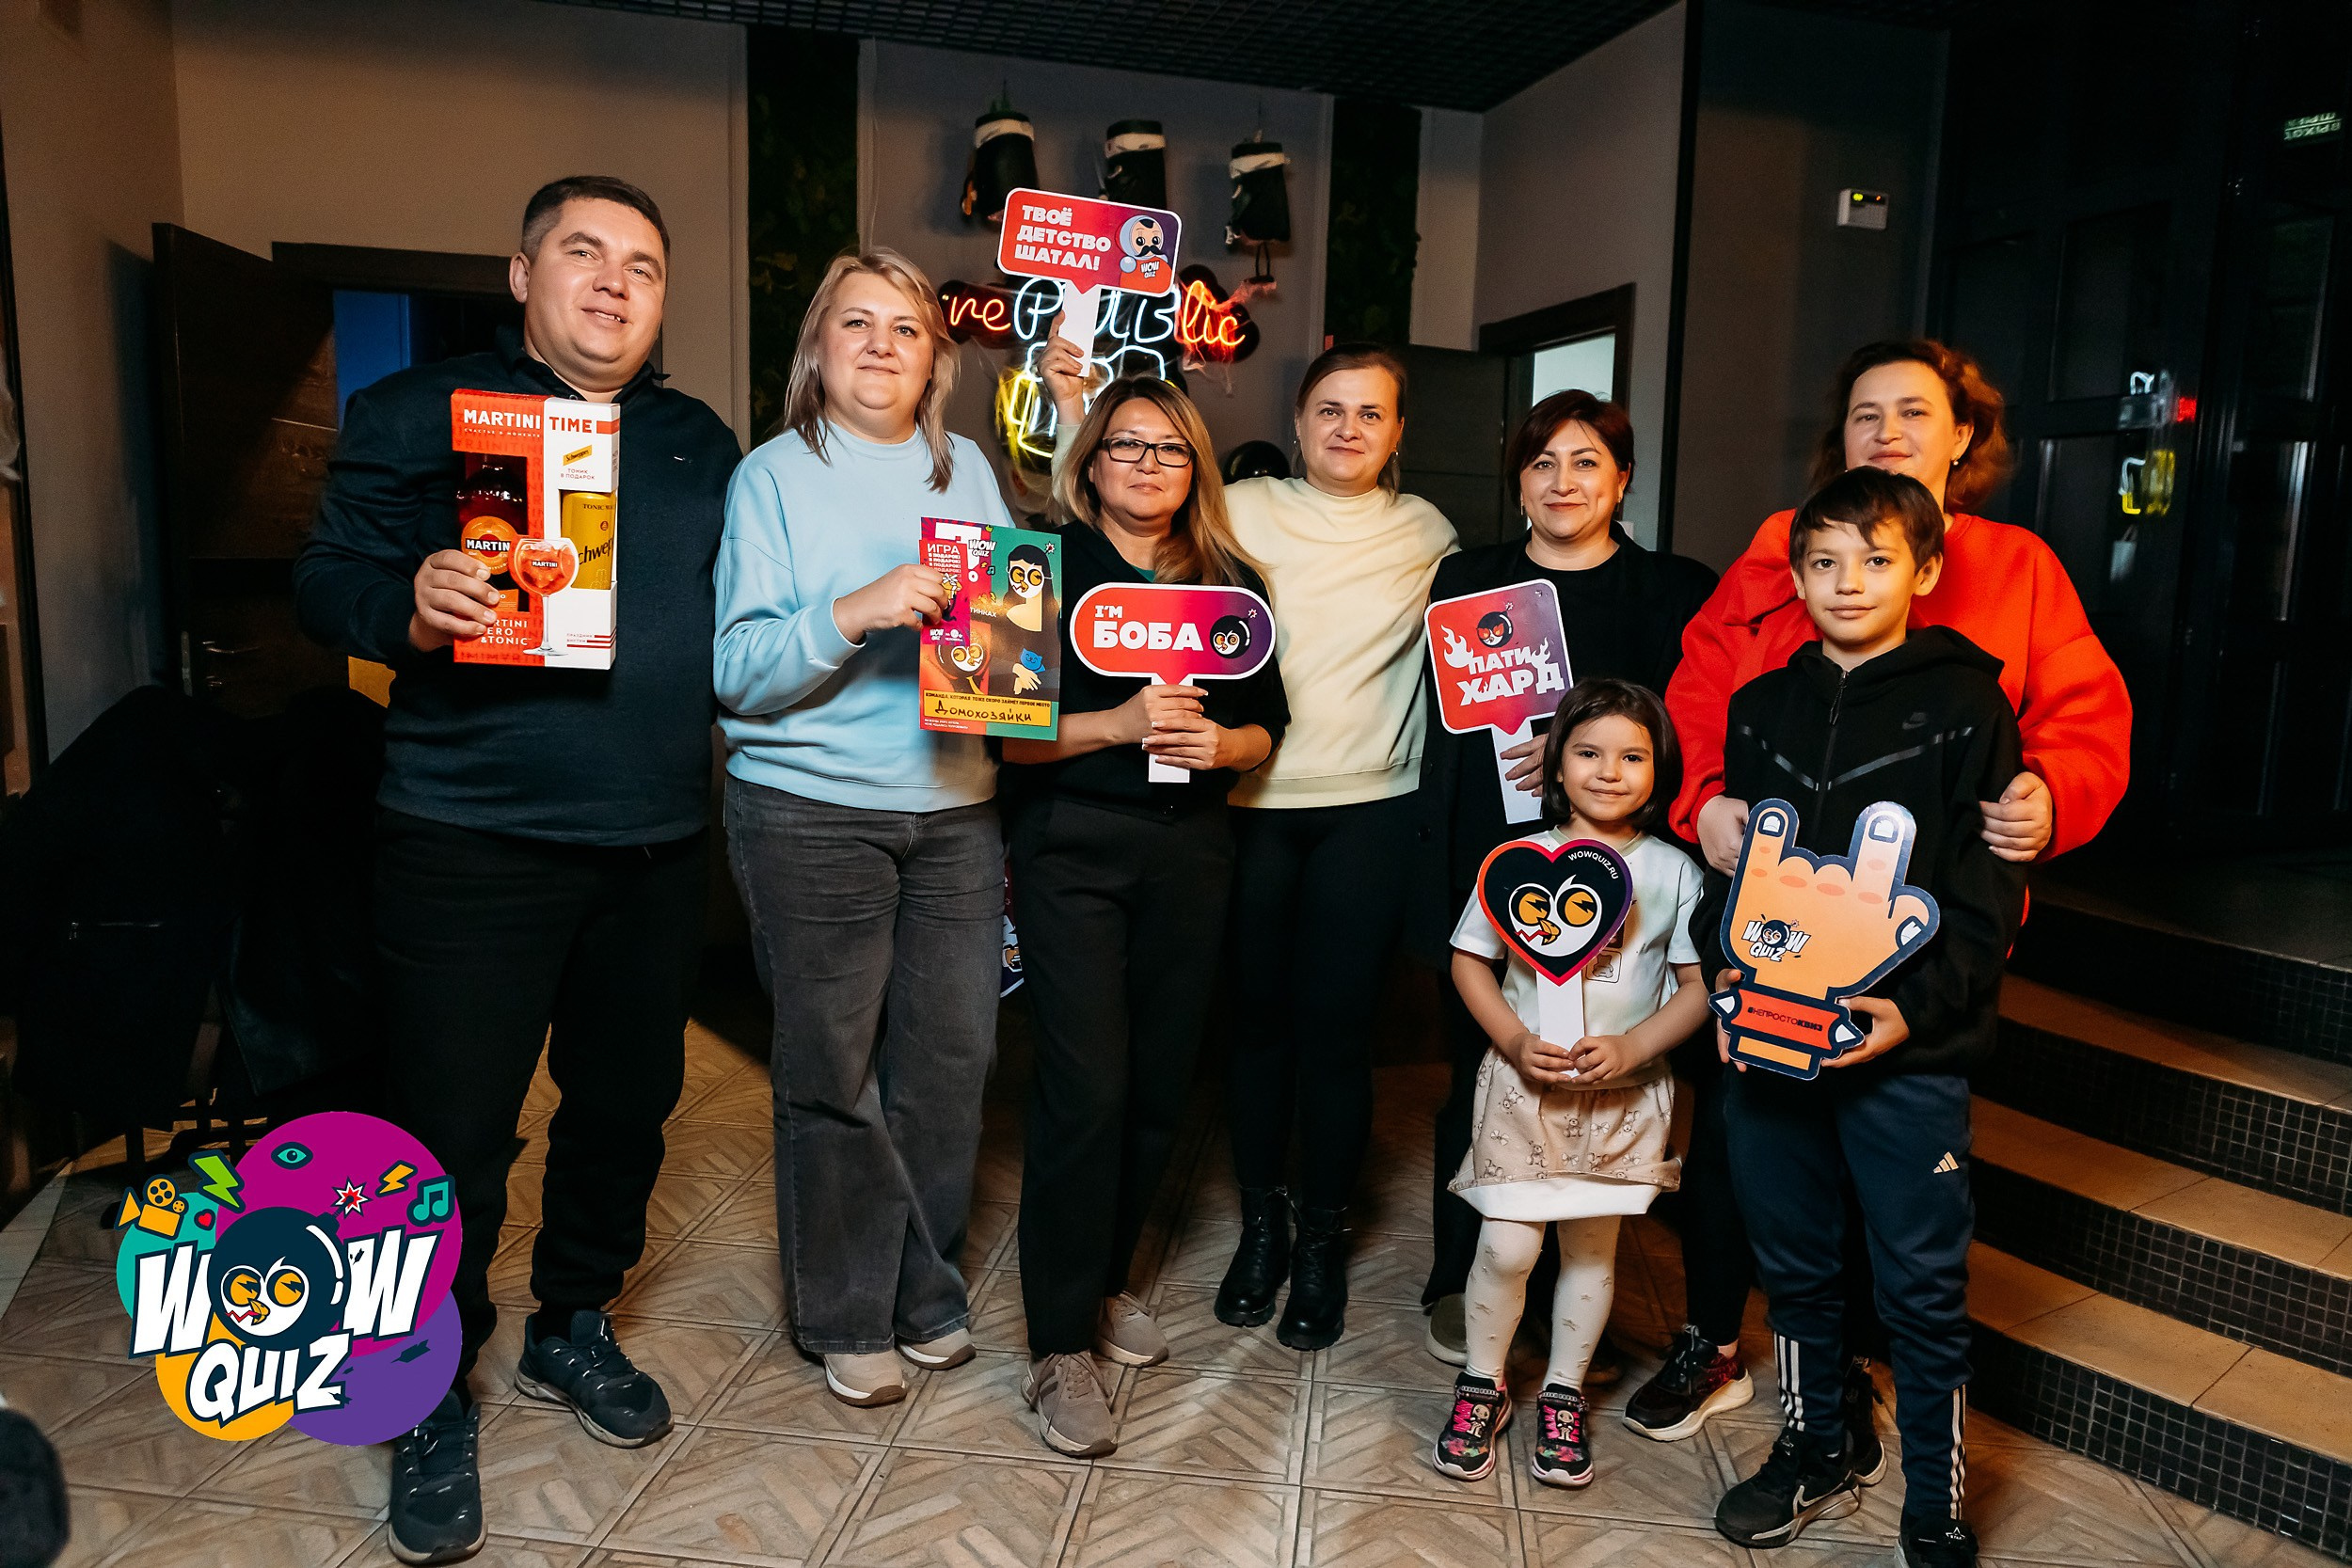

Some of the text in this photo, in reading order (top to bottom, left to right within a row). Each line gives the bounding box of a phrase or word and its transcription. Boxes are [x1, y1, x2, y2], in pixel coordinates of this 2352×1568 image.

[1022, 205, 1073, 226] ТВОЁ
[1016, 225, 1111, 252] ДЕТСТВО
[1014, 244, 1100, 271] ШАТАЛ!
[1140, 261, 1160, 273] WOW
[464, 408, 592, 434] MARTINI TIME
[466, 539, 510, 551] MARTIN
[928, 543, 960, 555] ИГРА
[968, 539, 996, 551] WOW
[972, 549, 989, 558] QUIZ
[1094, 605, 1123, 619] I'M
[486, 626, 514, 636] ERO
[495, 619, 528, 628] RTINI
[481, 635, 528, 645] &TONIC
[1093, 620, 1204, 651] БОБА
[1468, 646, 1533, 675] ПАТИ
[1456, 661, 1565, 706] ХАРД
[1567, 850, 1619, 879] WOWQUIZ.RU
[1749, 942, 1788, 962] QUIZ
